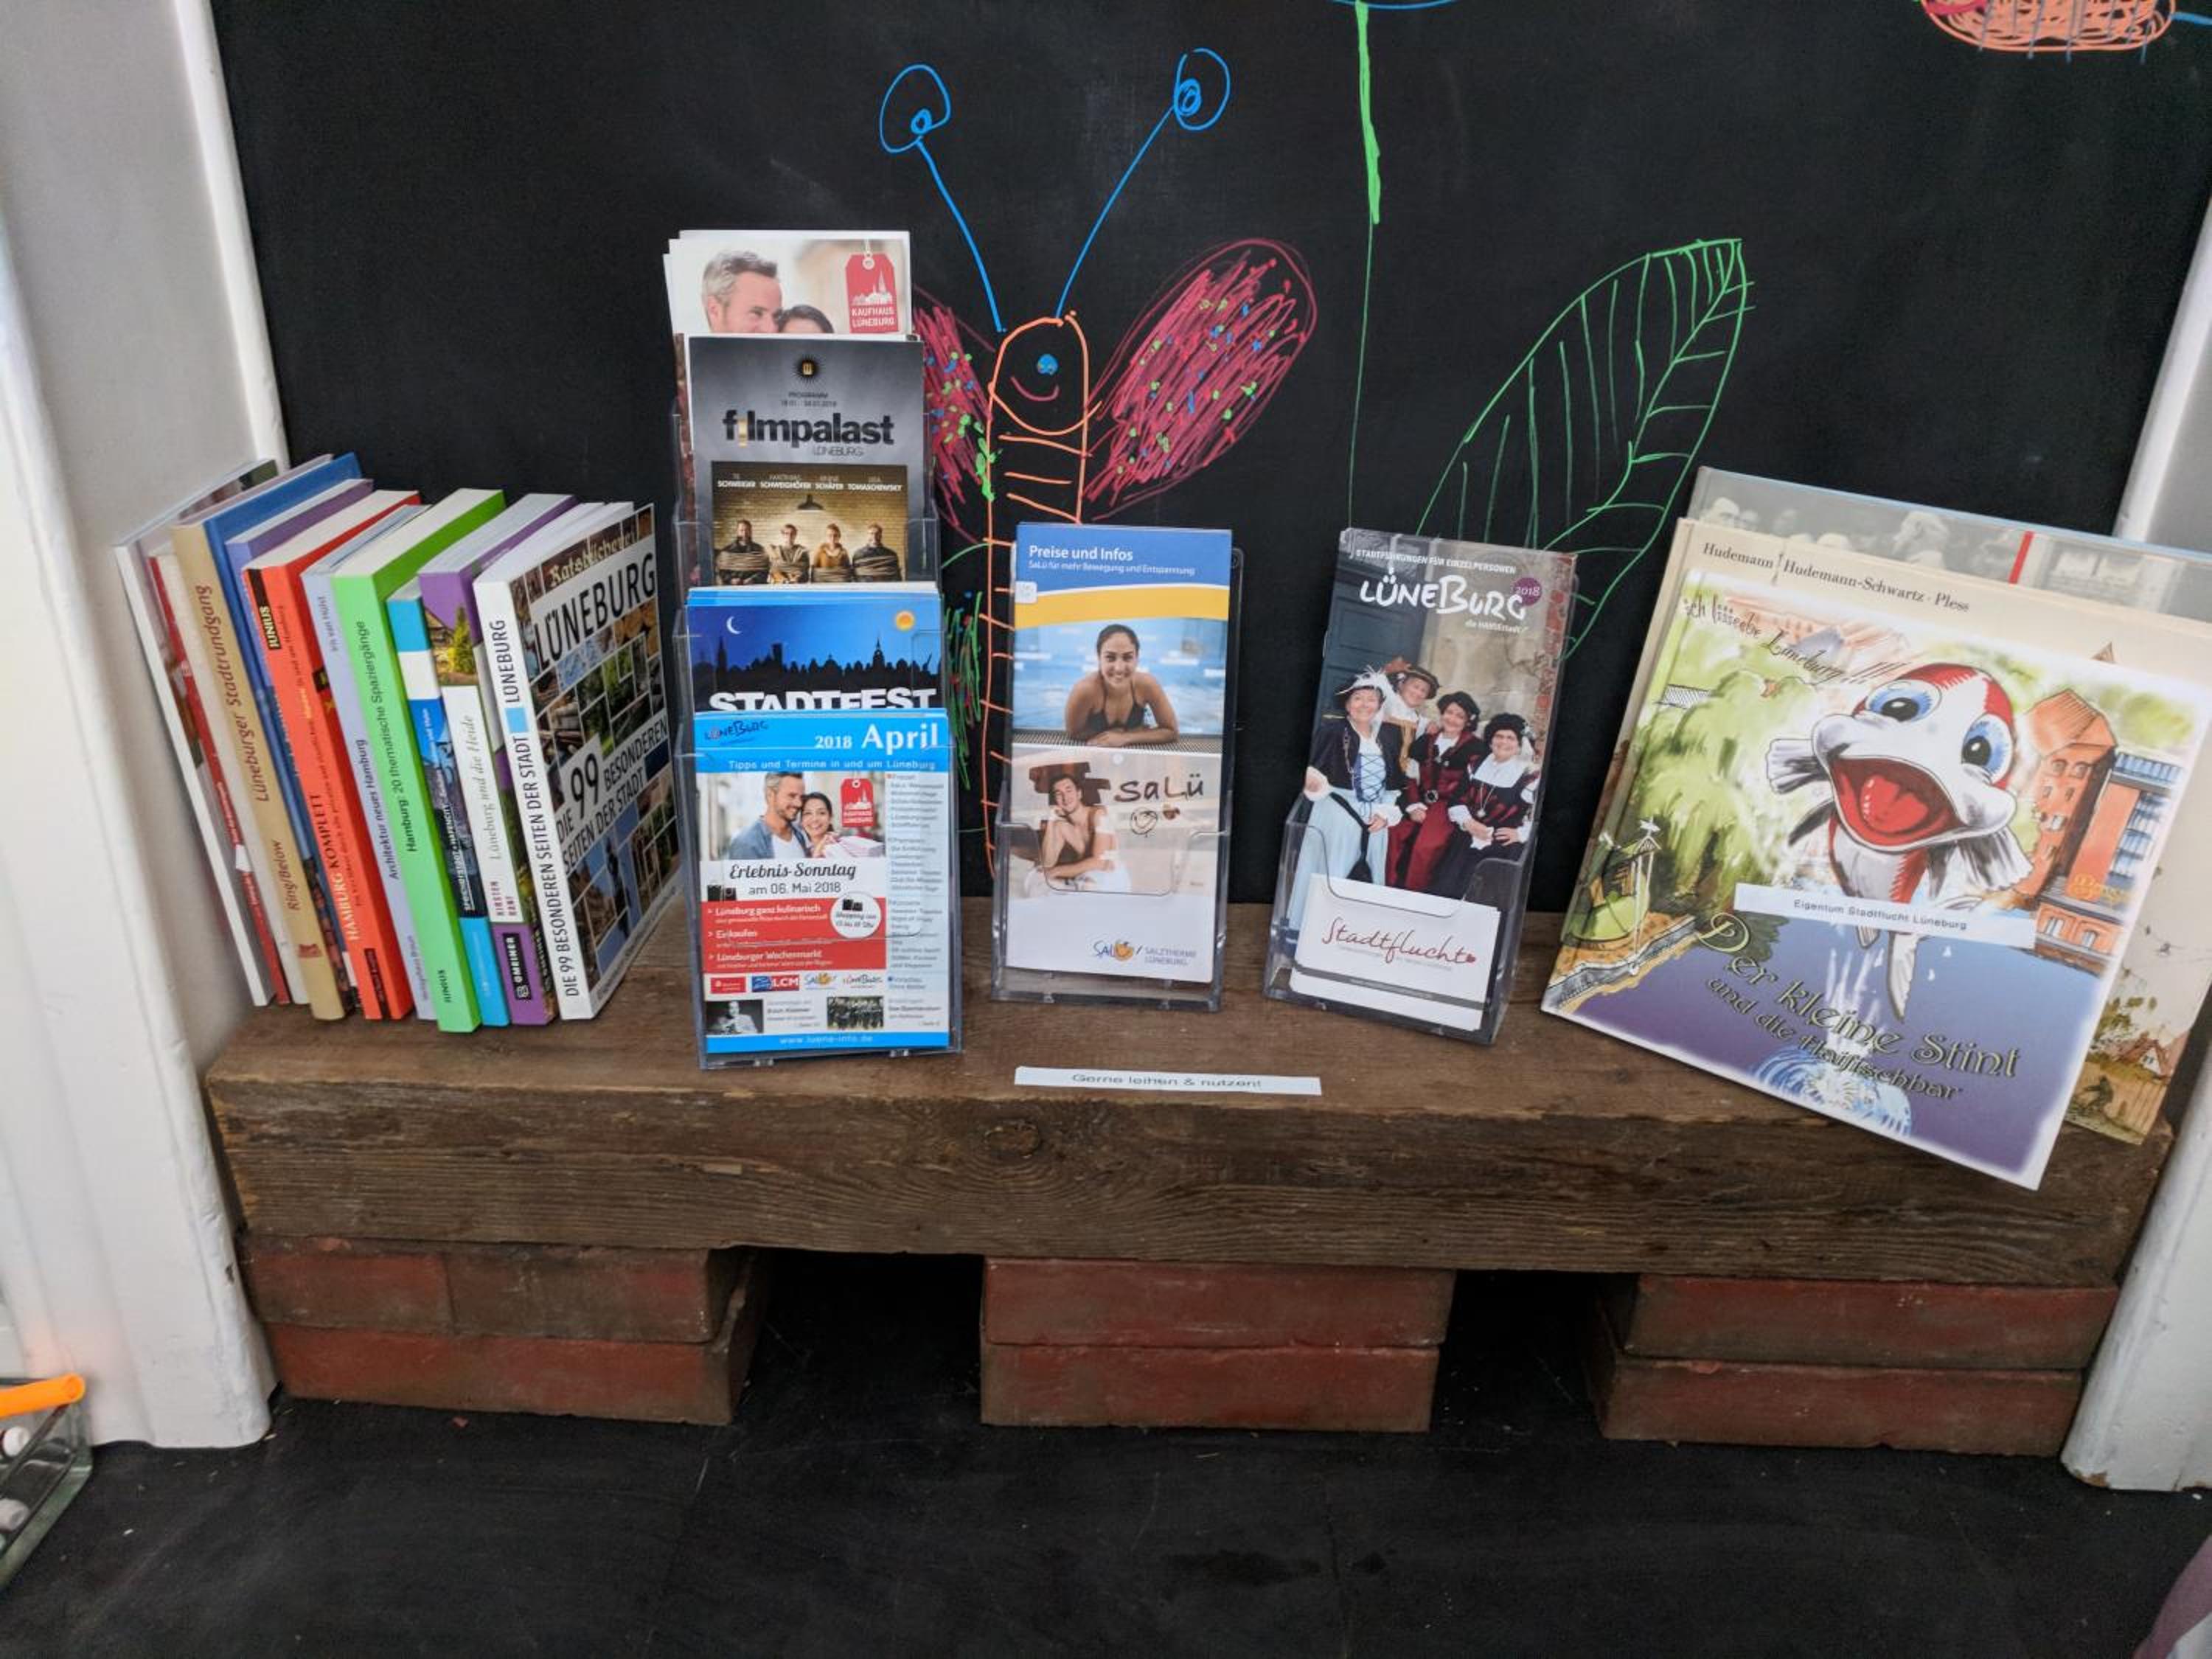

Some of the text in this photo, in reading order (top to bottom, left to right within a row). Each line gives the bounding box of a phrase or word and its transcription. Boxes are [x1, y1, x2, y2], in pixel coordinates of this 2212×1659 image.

[852, 306, 894, 316] KAUFHAUS
[852, 317, 894, 329] LÜNEBURG
[723, 410, 894, 449] filmpalast
[1029, 546, 1133, 561] Preise und Infos
[1446, 558, 1517, 575] EINZELPERSONEN
[1515, 586, 1540, 597] 2018
[1703, 543, 1969, 613] Hudemann Hudemann-Schwartz Pless
[259, 605, 281, 650] JUNIUS
[534, 552, 655, 667] LÜNEBURG
[357, 621, 382, 703] Spaziergänge
[489, 619, 520, 703] LÜNEBURG
[195, 585, 270, 802] Lüneburger Stadtrundgang
[709, 687, 938, 712] STADTFEST
[378, 706, 399, 776] thematische
[815, 723, 939, 755] 2018 April
[557, 720, 670, 842] DIE 99 BESONDEREN
[729, 759, 936, 771] Tipps und Termine in und um Lüneburg
[391, 779, 403, 794] 20
[463, 715, 503, 860] Lüneburg und die Heide
[355, 740, 400, 880] Architektur neues Hamburg
[562, 768, 646, 873] SEITEN DER STADT
[311, 794, 341, 870] KOMPLETT
[273, 841, 299, 911] Ring/Below
[517, 737, 580, 997] DIE 99 BESONDEREN SEITEN DER STADT
[729, 862, 857, 880] Erlebnis-Sonntag
[332, 872, 361, 941] HAMBURG
[749, 886, 767, 895] am
[792, 883, 810, 894] Mai
[815, 882, 841, 894] 2018
[715, 906, 754, 917] Lüneburg
[1794, 899, 1967, 931] Eigentum Stadtflucht Lüneburg
[717, 952, 764, 961] Lüneburger
[1322, 917, 1469, 964] Stadtflucht
[438, 970, 451, 1003] JUNIUS
[1756, 1012, 1796, 1040] die
[1778, 979, 1904, 1054] kleine
[1911, 1032, 2021, 1078] Stint
[1073, 1074, 1262, 1088] Gerne leihen & nutzen!
